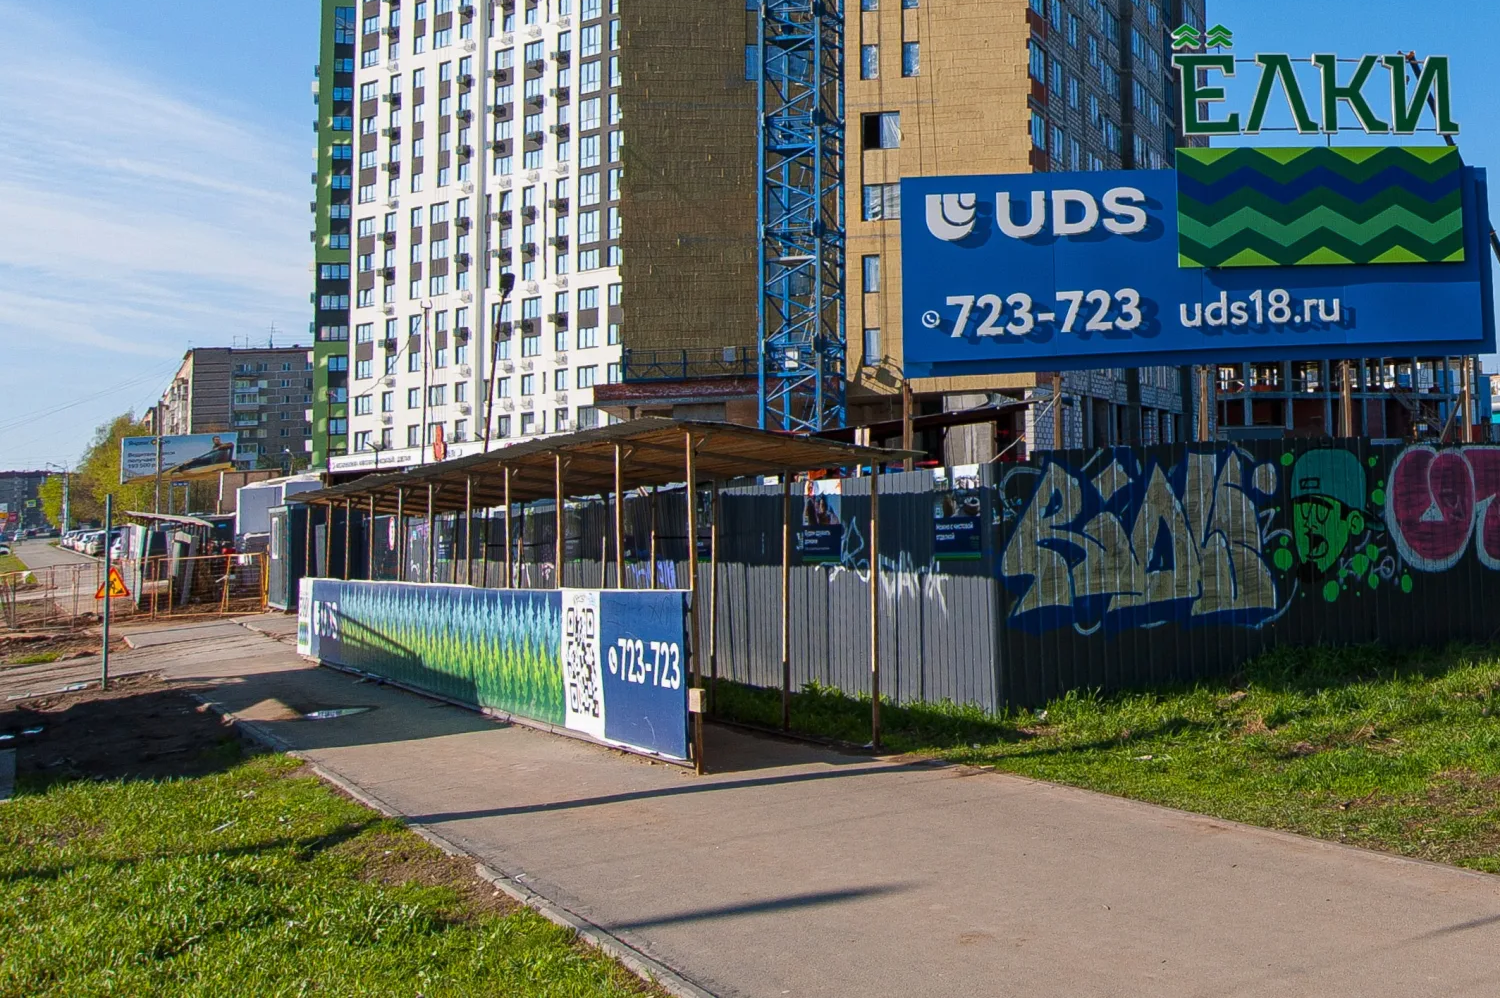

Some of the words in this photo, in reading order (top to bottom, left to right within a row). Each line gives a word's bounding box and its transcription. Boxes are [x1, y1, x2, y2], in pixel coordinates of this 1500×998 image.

[995, 186, 1148, 240] UDS
[946, 287, 1143, 338] 723-723
[1179, 288, 1341, 328] uds18.ru
[617, 637, 681, 690] 723-723
